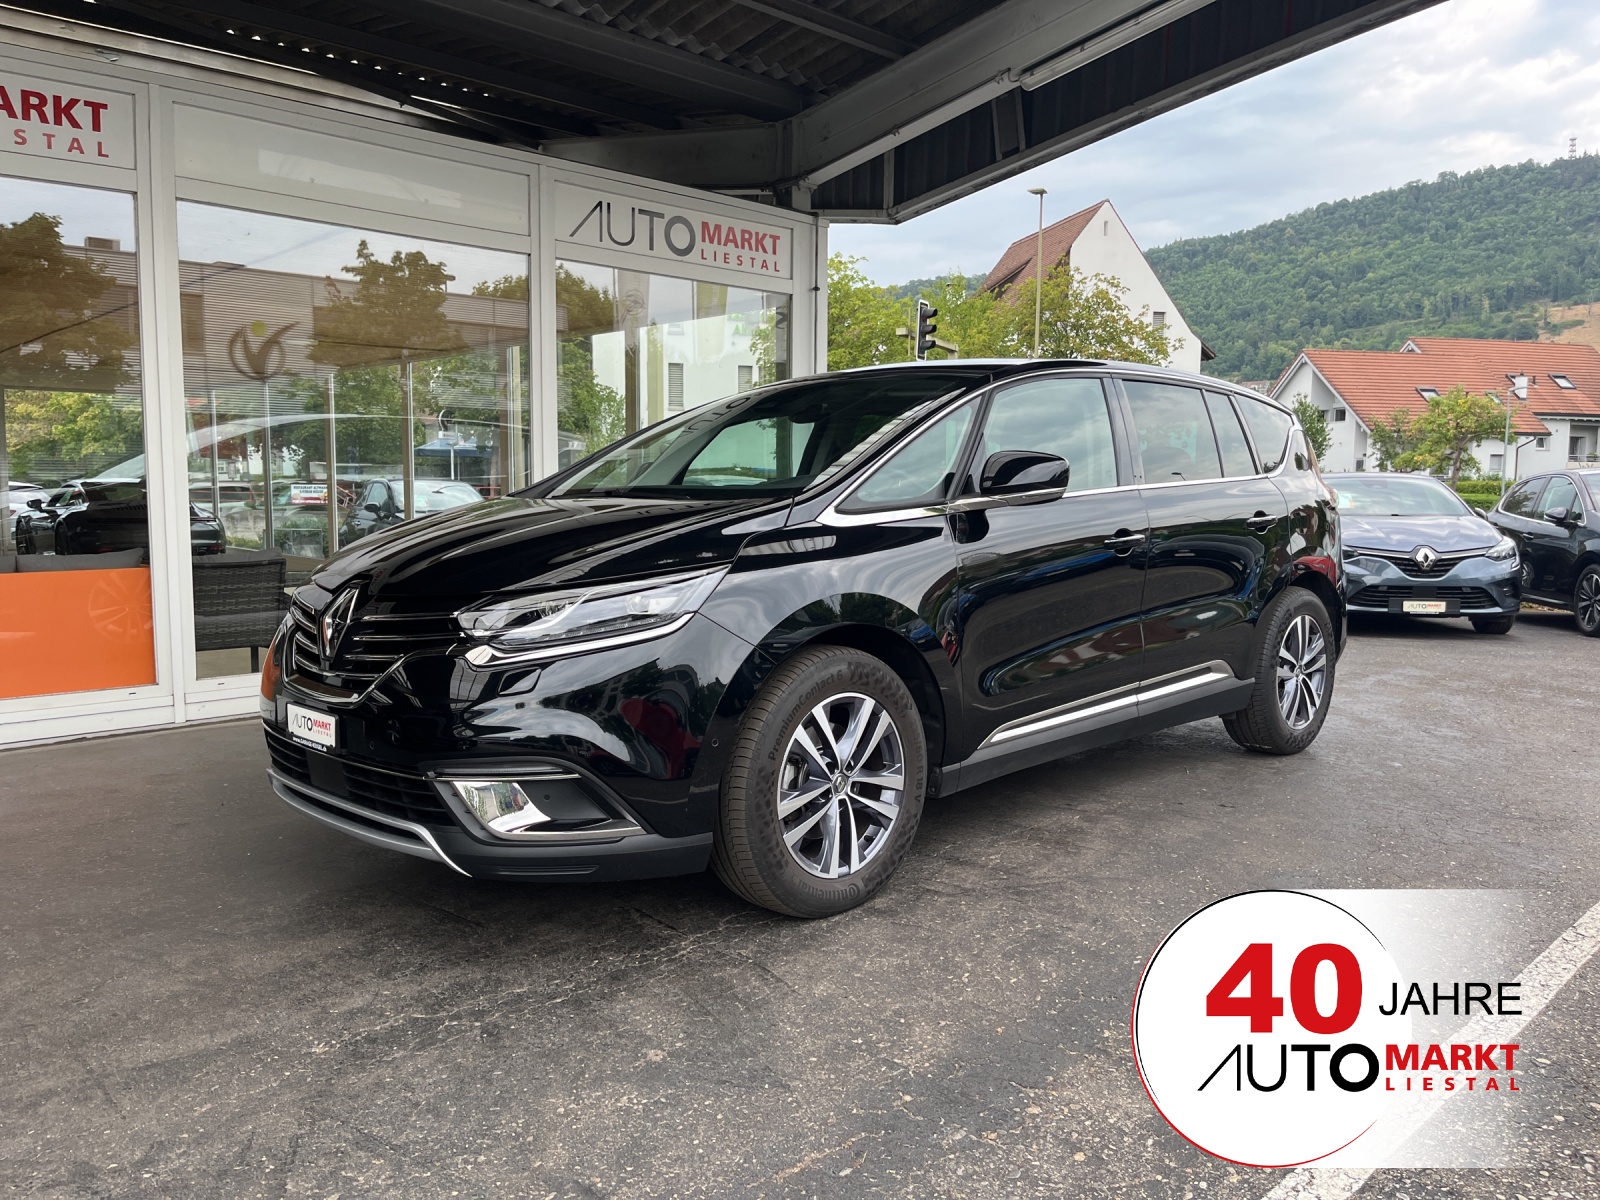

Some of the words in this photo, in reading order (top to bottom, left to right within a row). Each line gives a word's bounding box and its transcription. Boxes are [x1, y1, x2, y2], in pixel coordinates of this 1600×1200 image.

[13, 128, 109, 158] STAL
[569, 200, 696, 257] AUTO
[701, 221, 780, 255] MARKT
[701, 248, 780, 272] LIESTAL
[292, 713, 313, 732] AUTO
[313, 719, 331, 732] MARKT
[767, 673, 835, 761] PremiumContact
[836, 669, 843, 681] 6
